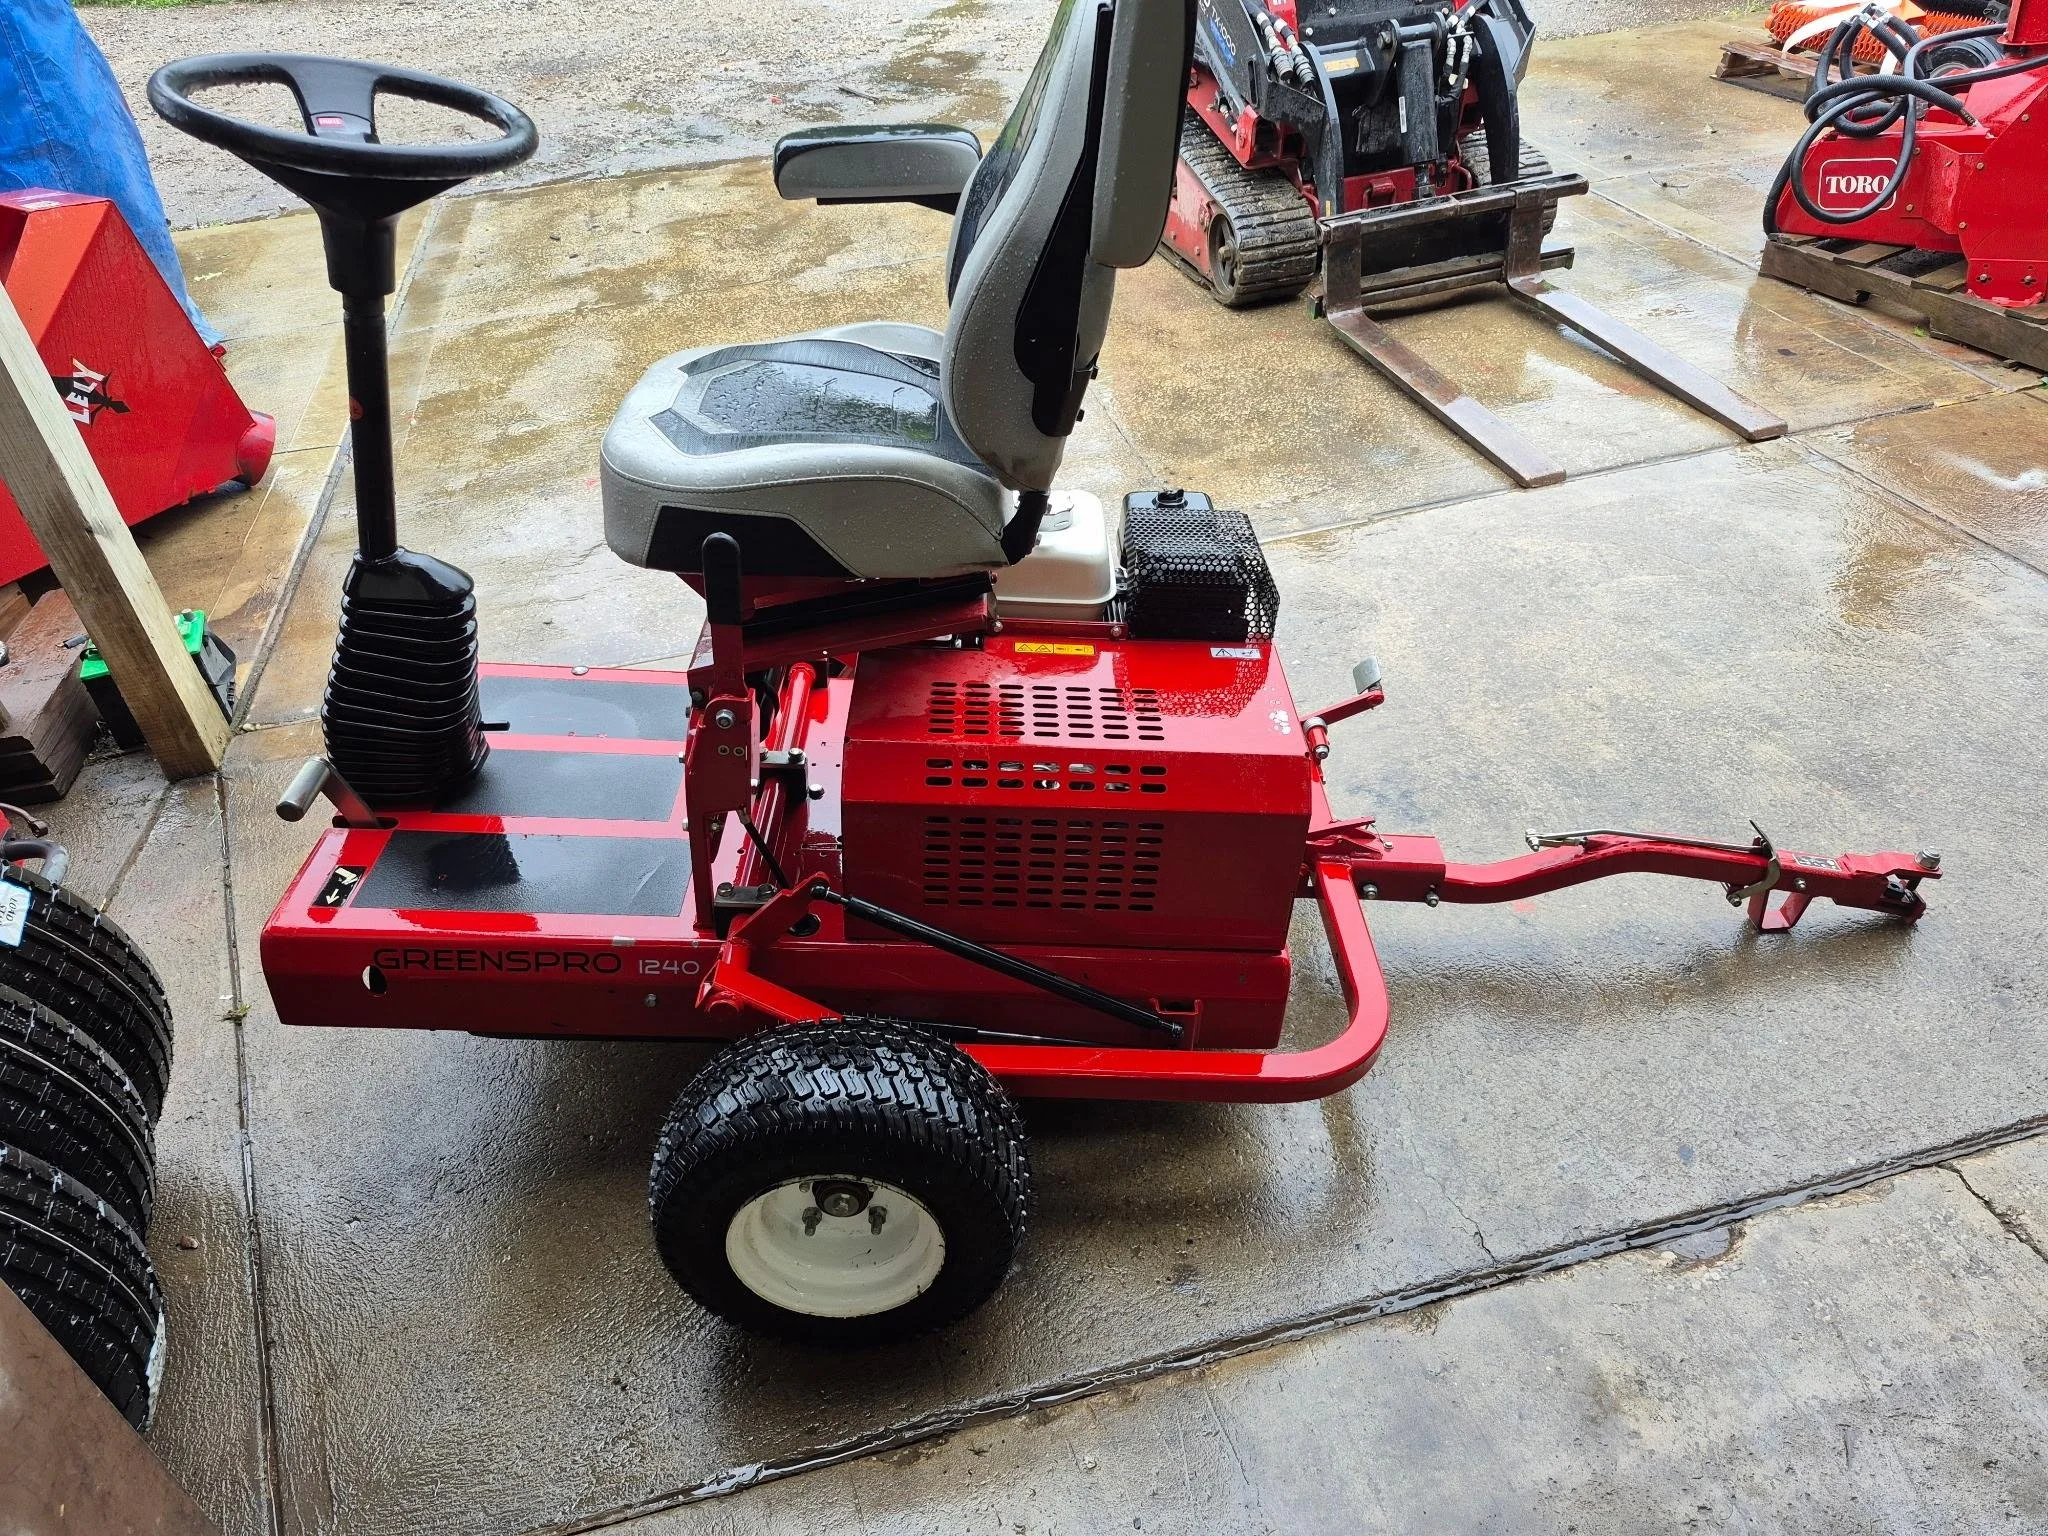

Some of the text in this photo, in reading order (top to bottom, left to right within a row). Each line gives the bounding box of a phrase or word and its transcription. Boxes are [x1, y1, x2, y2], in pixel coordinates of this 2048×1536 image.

[1825, 175, 1889, 193] TORO
[66, 357, 106, 425] LELY
[6, 897, 17, 921] LOAD
[373, 947, 700, 975] GREENSPRO 1240
